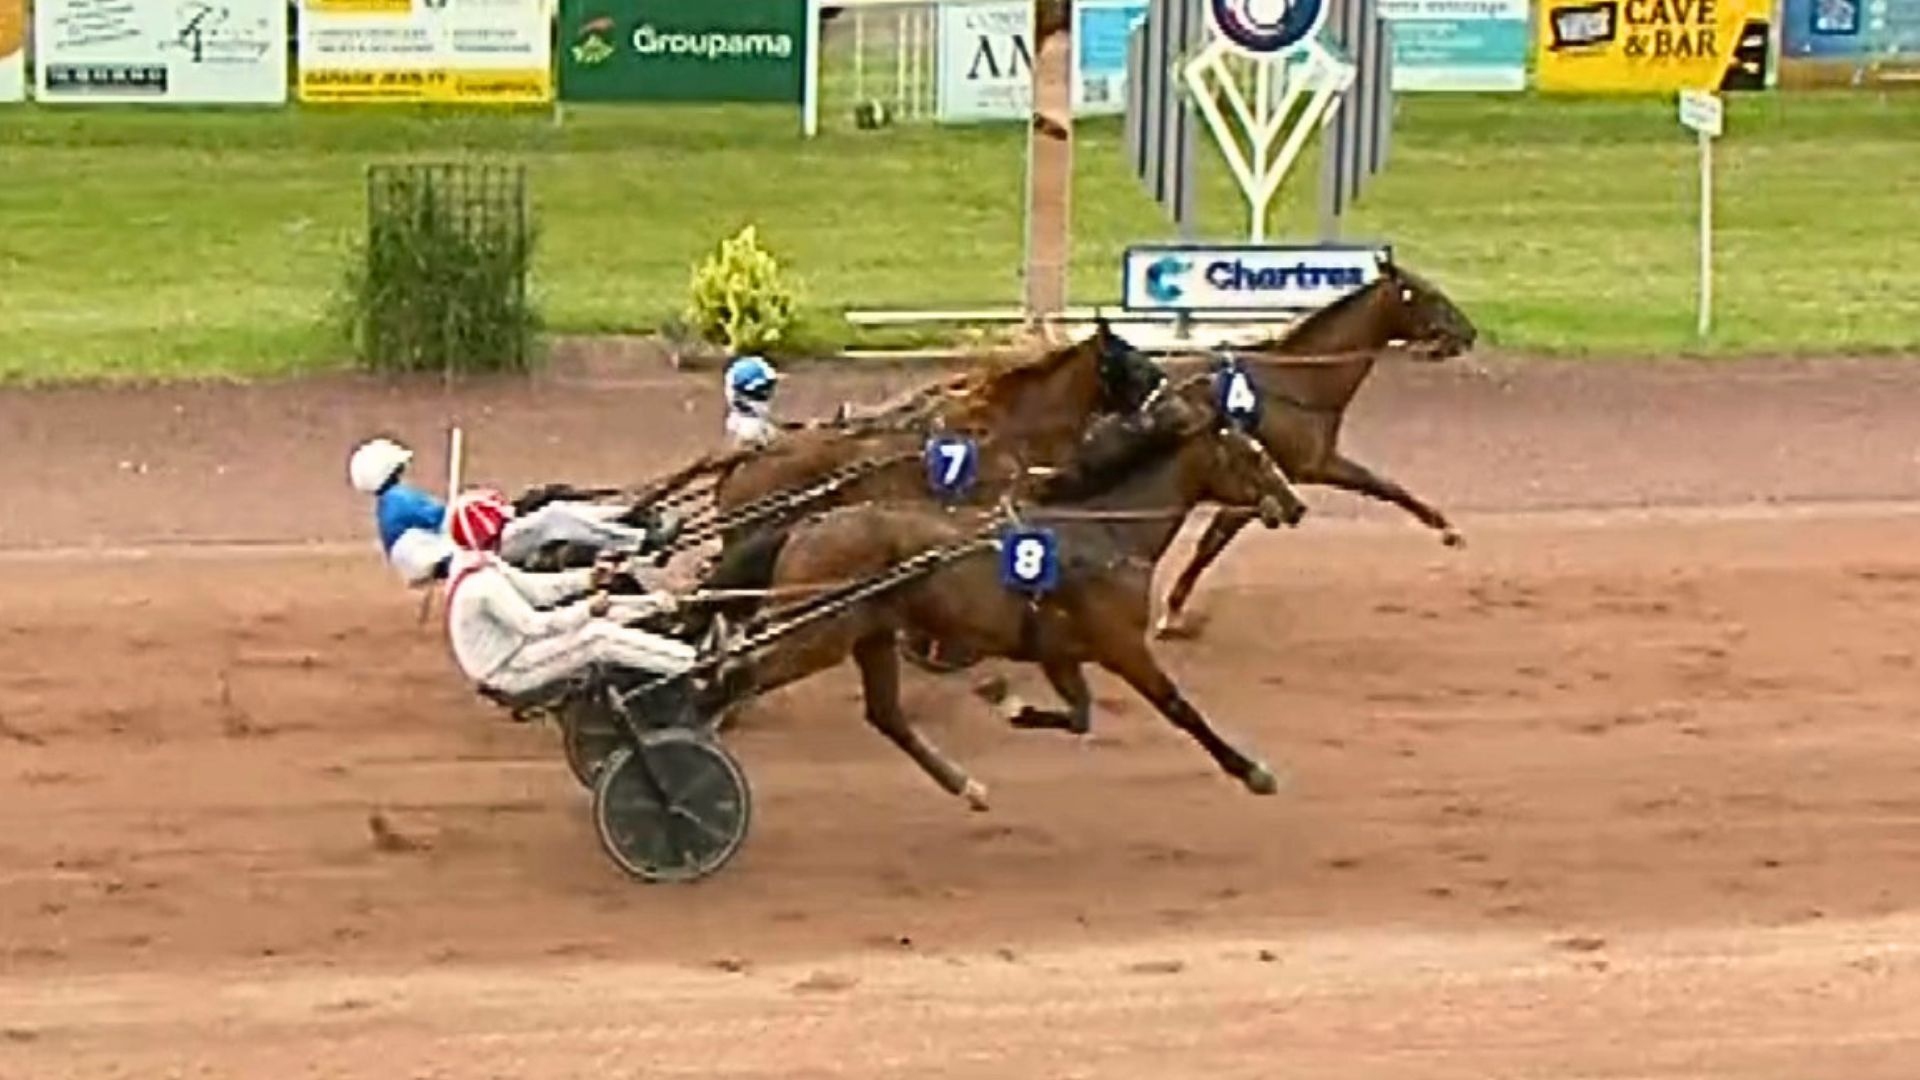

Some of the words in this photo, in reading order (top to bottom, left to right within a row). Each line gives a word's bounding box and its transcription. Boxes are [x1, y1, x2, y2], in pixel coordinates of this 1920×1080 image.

[1625, 0, 1717, 24] CAVE
[633, 25, 792, 58] Groupama
[1624, 34, 1649, 57] &
[1655, 29, 1718, 57] BAR
[1205, 259, 1364, 290] Chartres
[1226, 372, 1256, 413] 4
[940, 444, 967, 484] 7
[1013, 539, 1045, 579] 8
